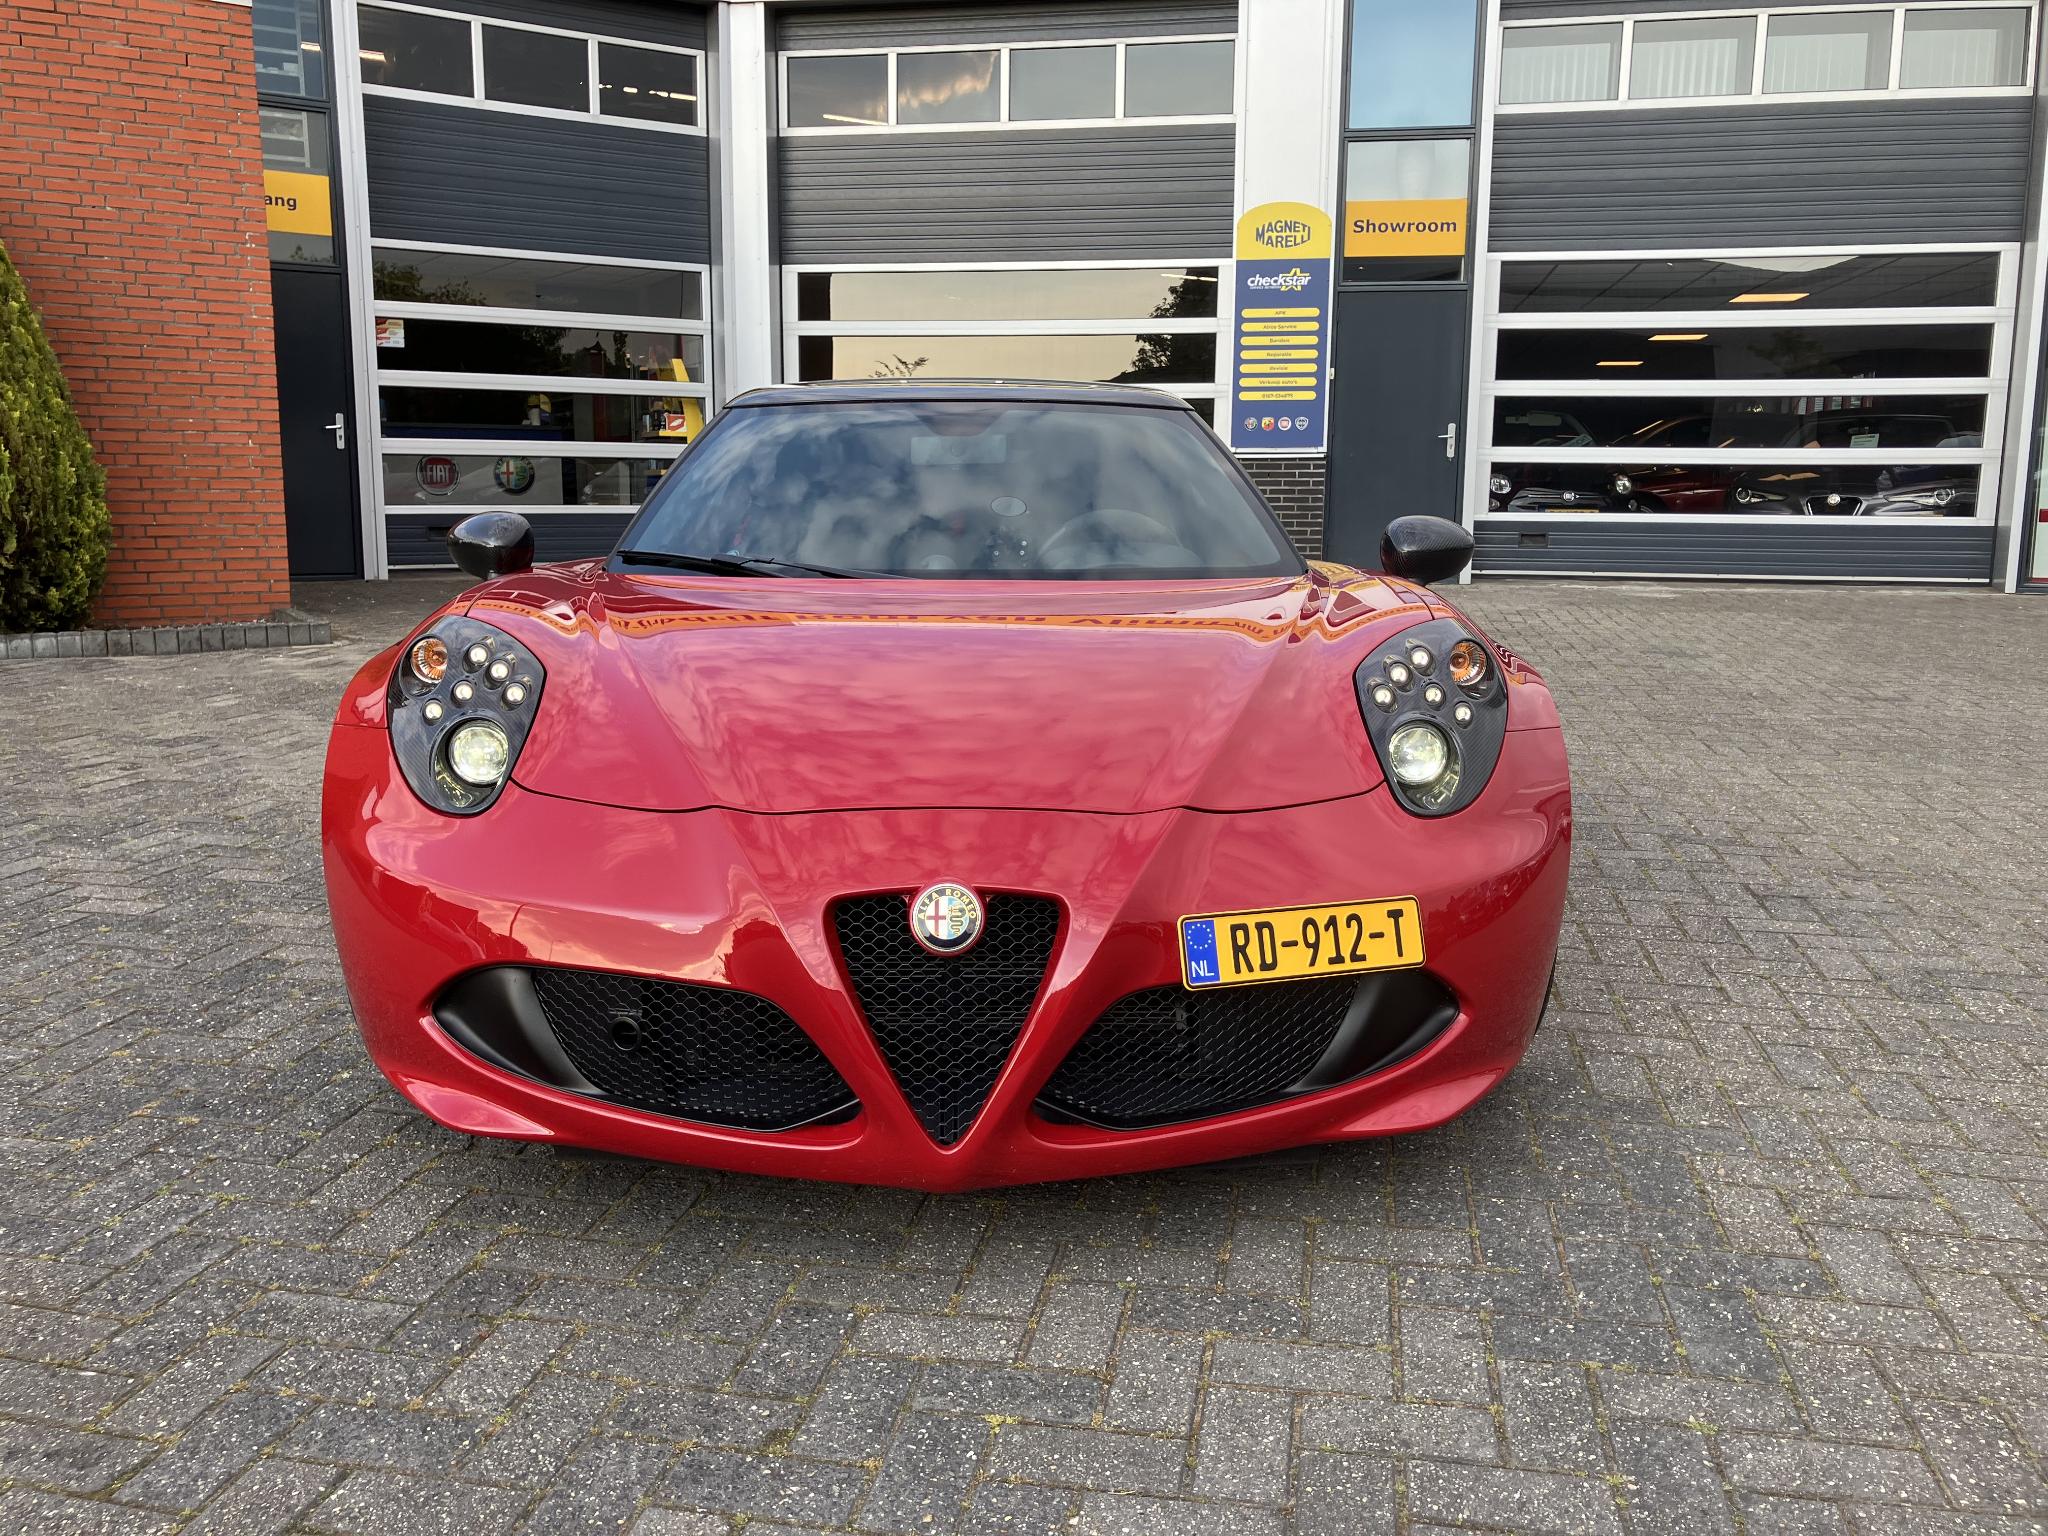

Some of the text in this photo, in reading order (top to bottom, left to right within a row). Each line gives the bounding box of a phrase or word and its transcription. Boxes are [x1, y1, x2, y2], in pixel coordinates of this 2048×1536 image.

[1352, 219, 1457, 233] Showroom
[1247, 274, 1311, 287] checkstar
[427, 464, 451, 482] FIAT
[918, 889, 977, 919] ALFA ROMEO
[1230, 909, 1404, 974] RD-912-T
[1191, 960, 1215, 977] NL
